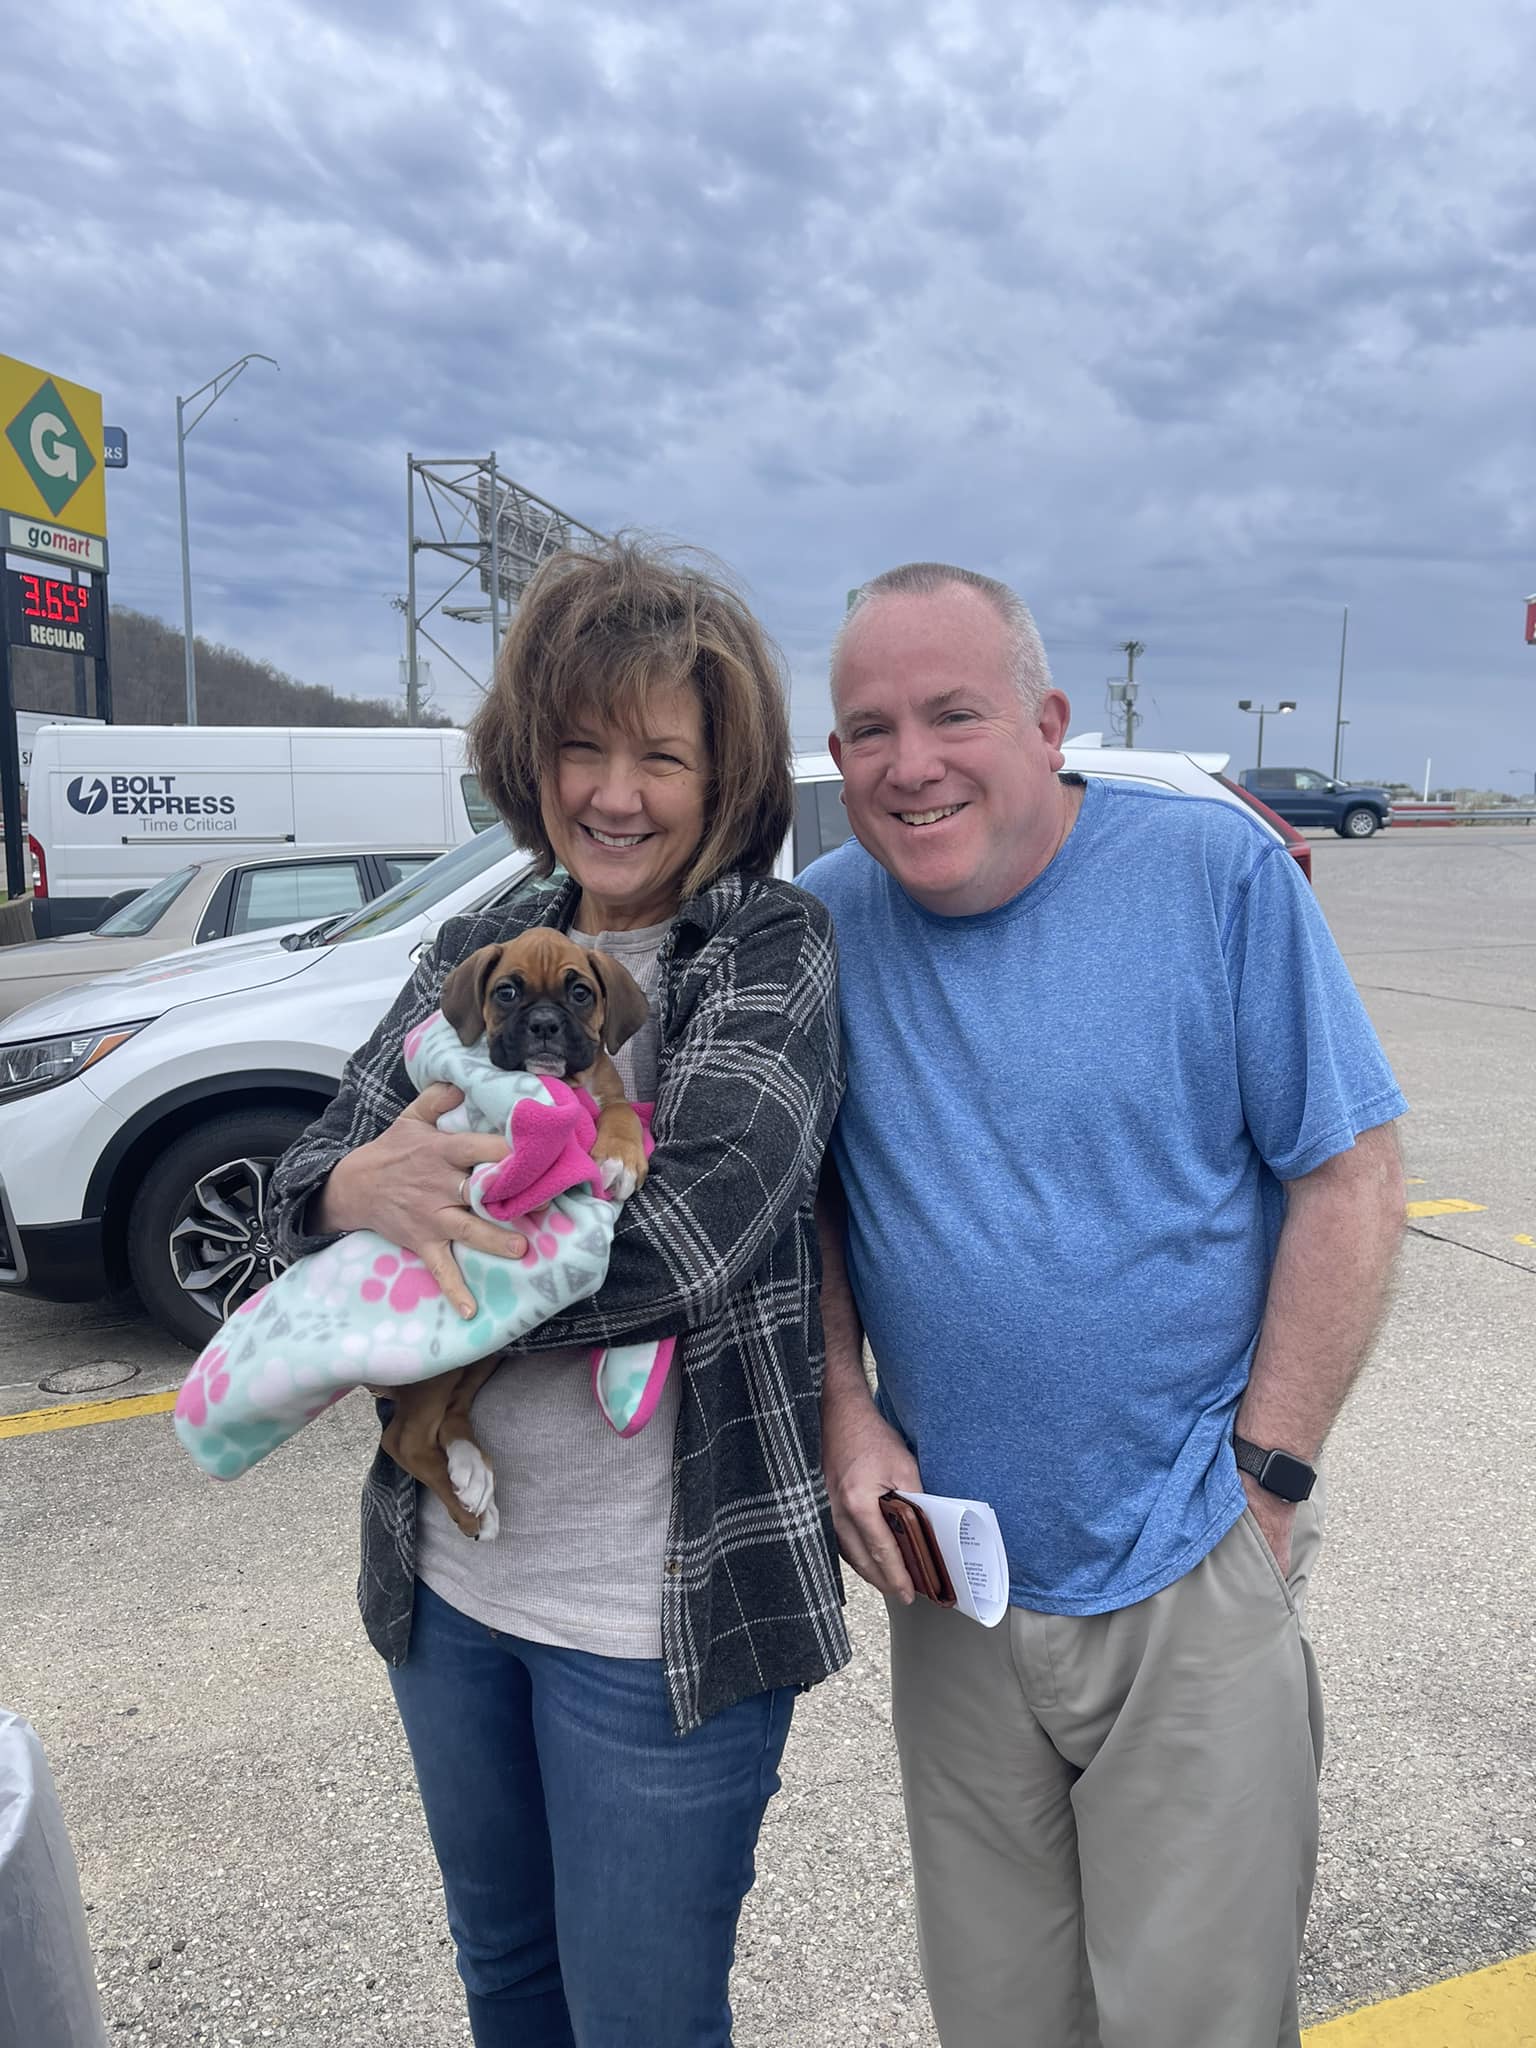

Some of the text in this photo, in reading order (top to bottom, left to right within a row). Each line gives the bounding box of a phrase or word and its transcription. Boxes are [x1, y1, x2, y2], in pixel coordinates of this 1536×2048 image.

[30, 412, 77, 482] G
[28, 527, 90, 557] gomart
[30, 624, 85, 651] REGULAR
[111, 776, 175, 794] BOLT
[112, 796, 235, 815] EXPRESS
[139, 817, 237, 831] Time Critical
